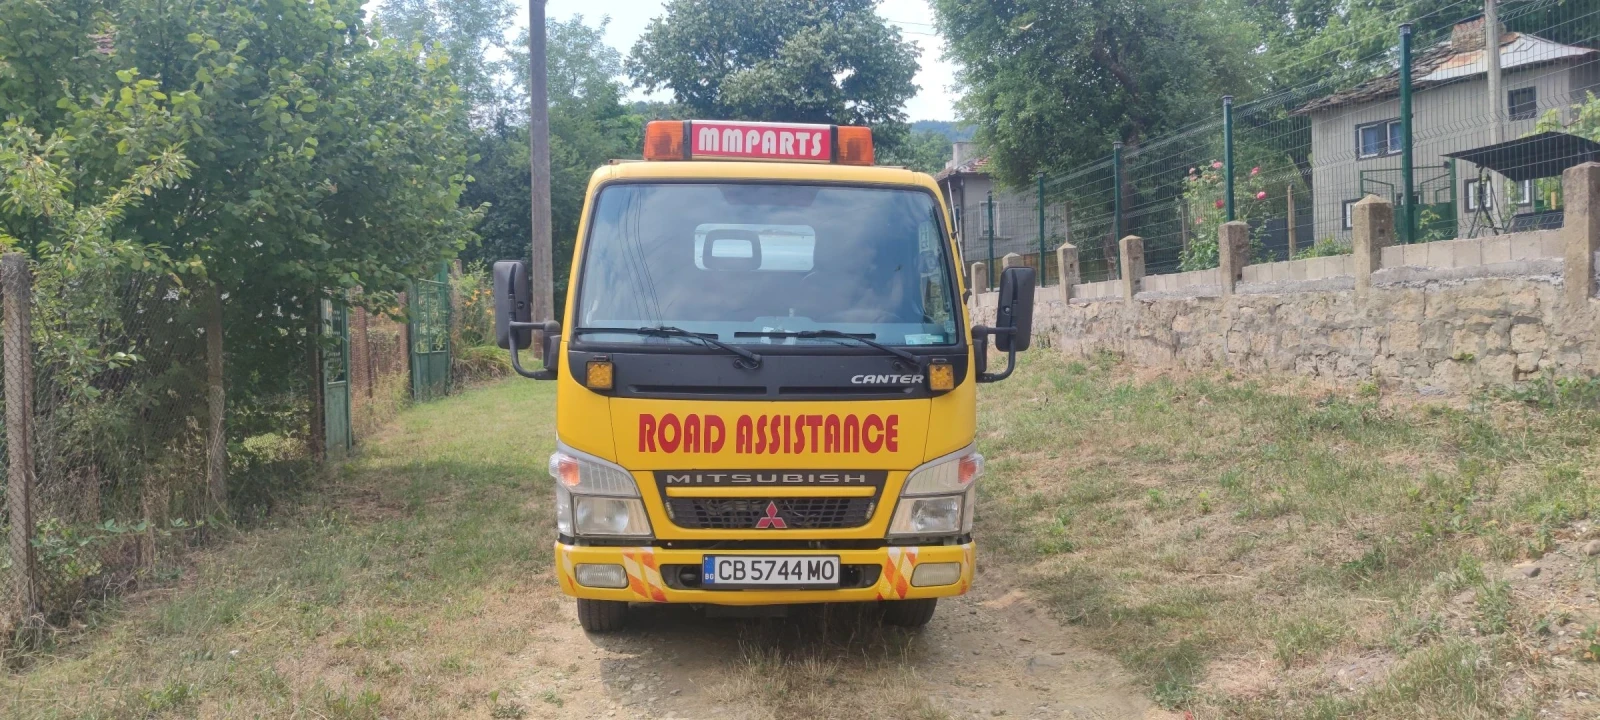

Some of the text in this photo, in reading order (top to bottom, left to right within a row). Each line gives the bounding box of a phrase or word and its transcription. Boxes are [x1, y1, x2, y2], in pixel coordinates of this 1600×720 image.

[698, 127, 822, 157] MMPARTS
[851, 374, 925, 385] CANTER
[638, 413, 899, 455] ROAD ASSISTANCE
[666, 474, 866, 484] MITSUBISH
[718, 559, 835, 581] CB 5744 MO
